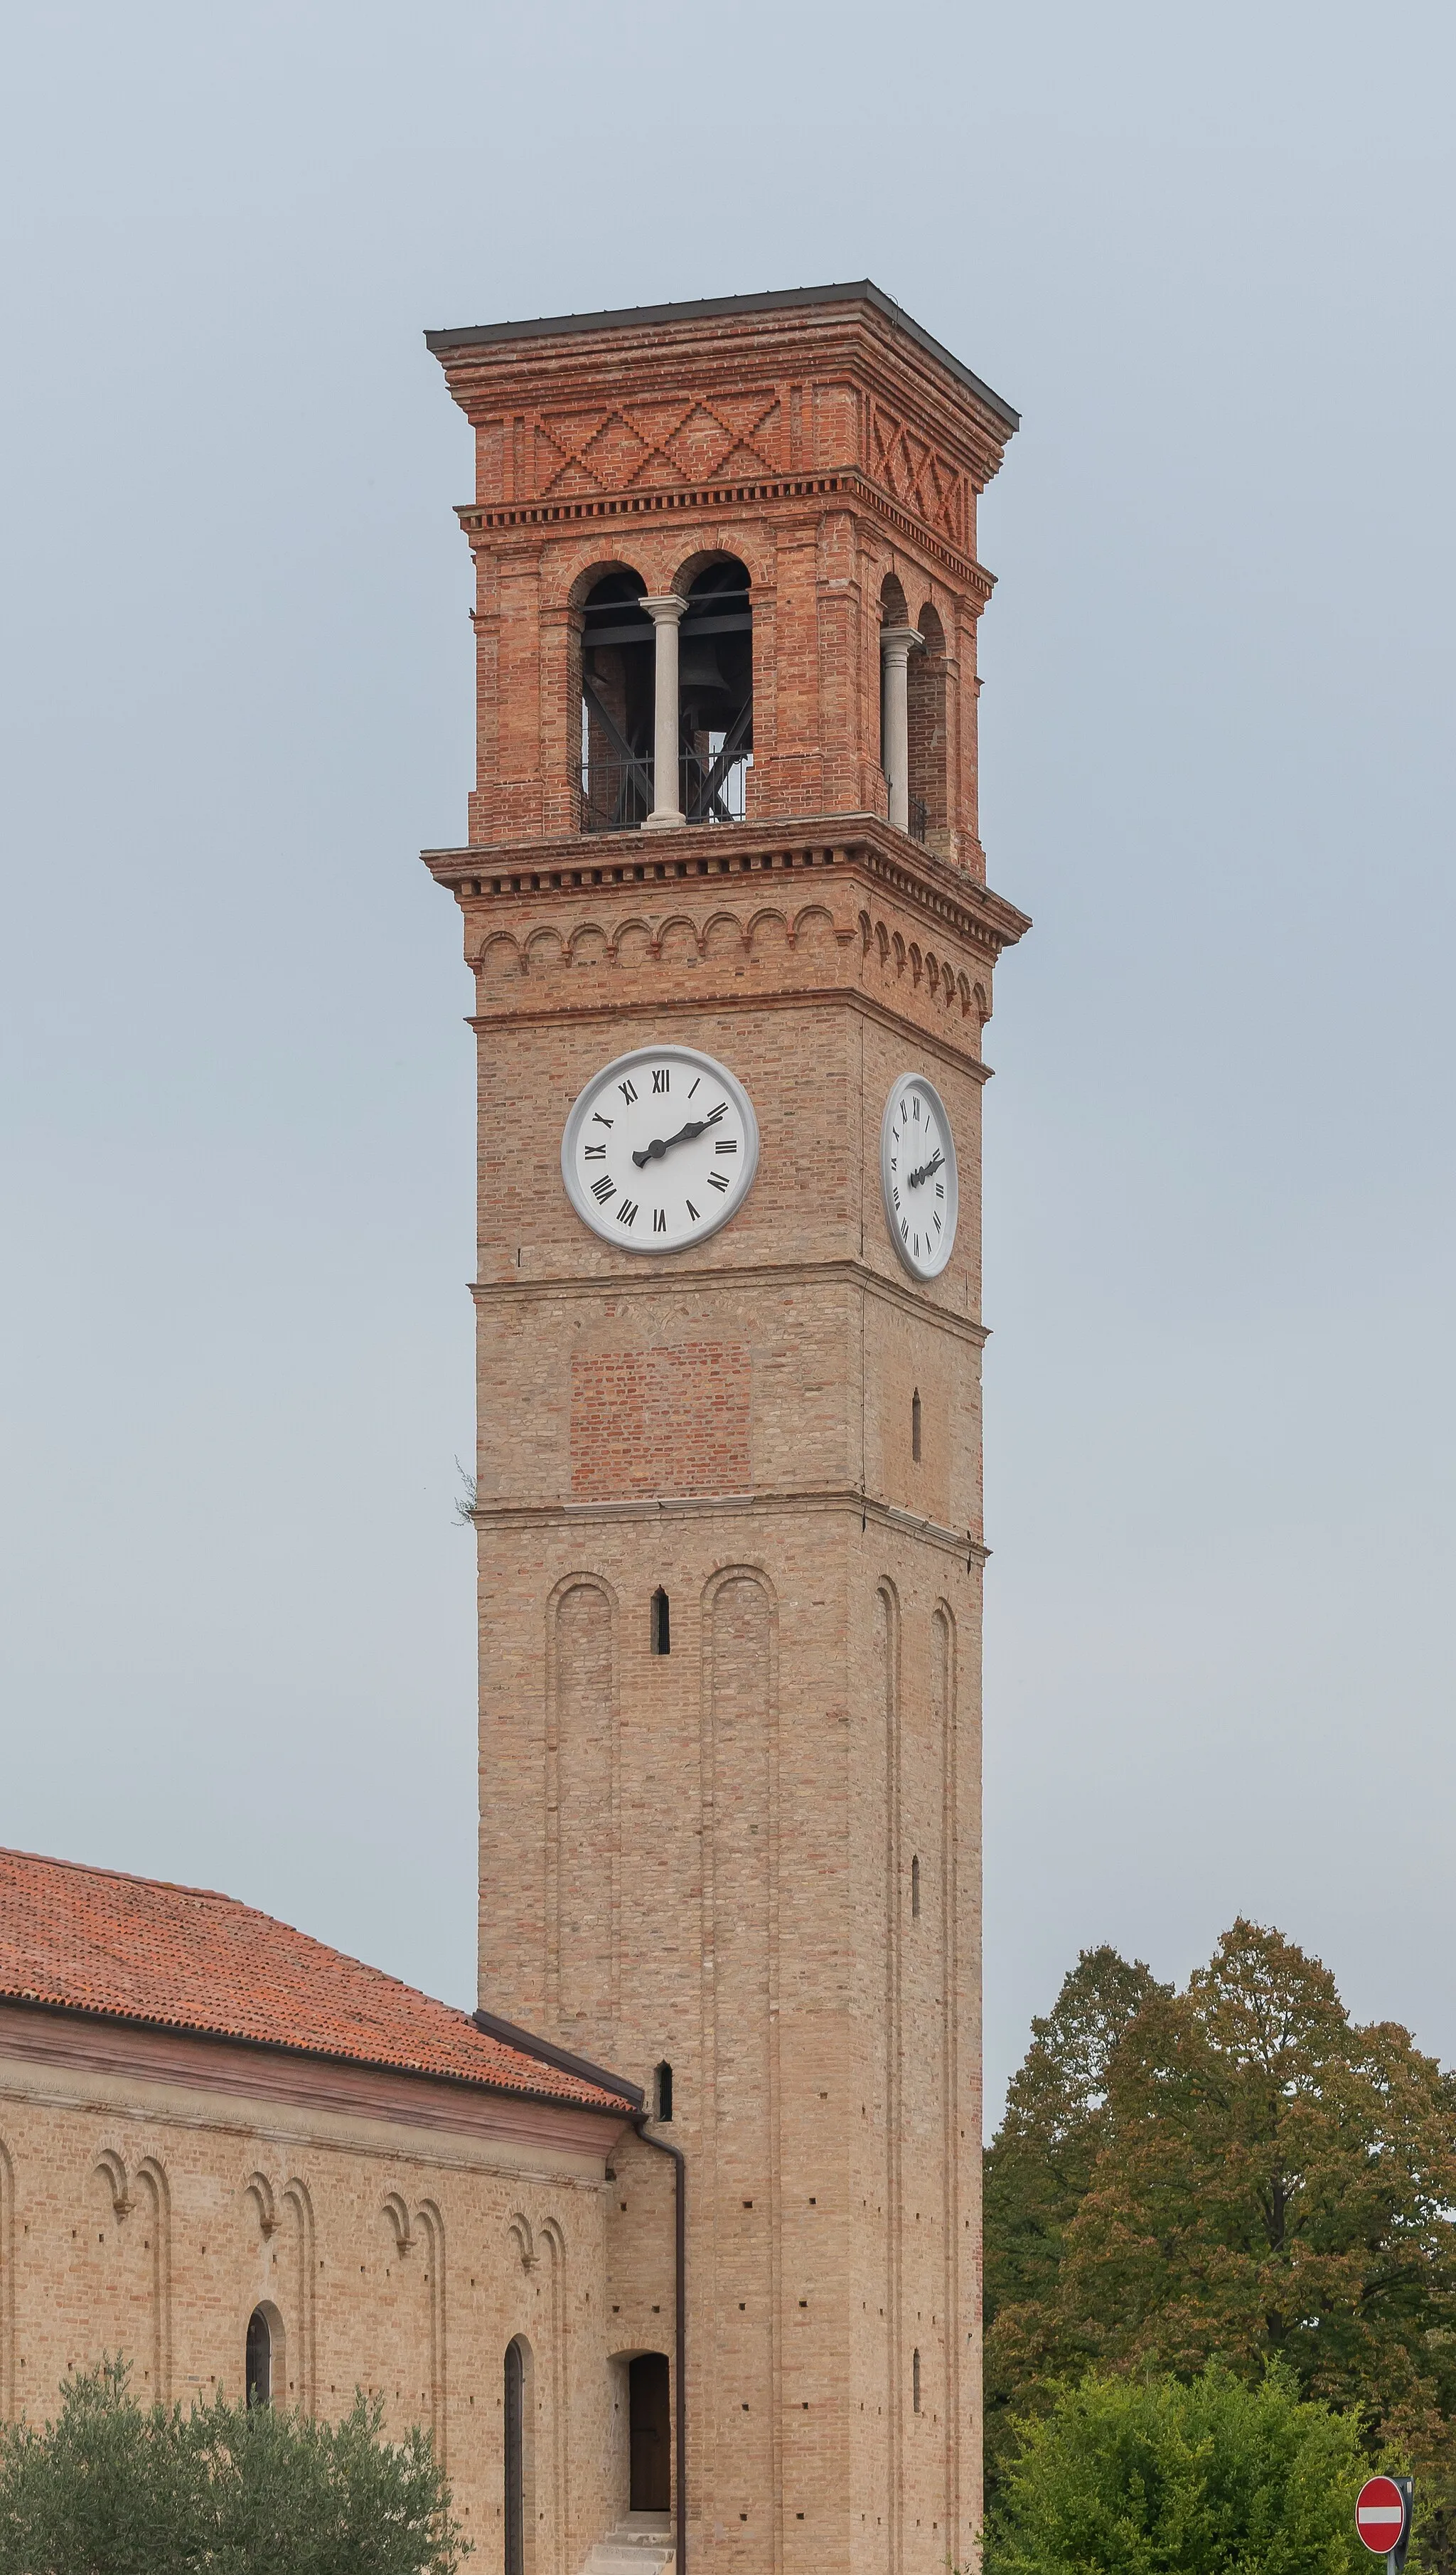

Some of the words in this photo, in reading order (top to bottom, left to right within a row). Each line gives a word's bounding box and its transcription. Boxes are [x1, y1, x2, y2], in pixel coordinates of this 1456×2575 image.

[618, 1079, 638, 1106] XI
[652, 1070, 670, 1093] XII
[687, 1078, 700, 1099] I
[592, 1112, 614, 1129] X
[707, 1102, 729, 1119] II
[899, 1099, 907, 1124] XI
[925, 1115, 930, 1133] I
[585, 1144, 606, 1160] IX
[715, 1140, 737, 1154] III
[590, 1175, 617, 1205] VIII
[707, 1171, 730, 1193] IV
[936, 1183, 944, 1199] III
[616, 1199, 638, 1227] VII
[653, 1209, 667, 1232] VI
[686, 1200, 700, 1221] V
[933, 1210, 941, 1234] IV
[914, 1232, 919, 1257] VI
[926, 1232, 931, 1254] V
